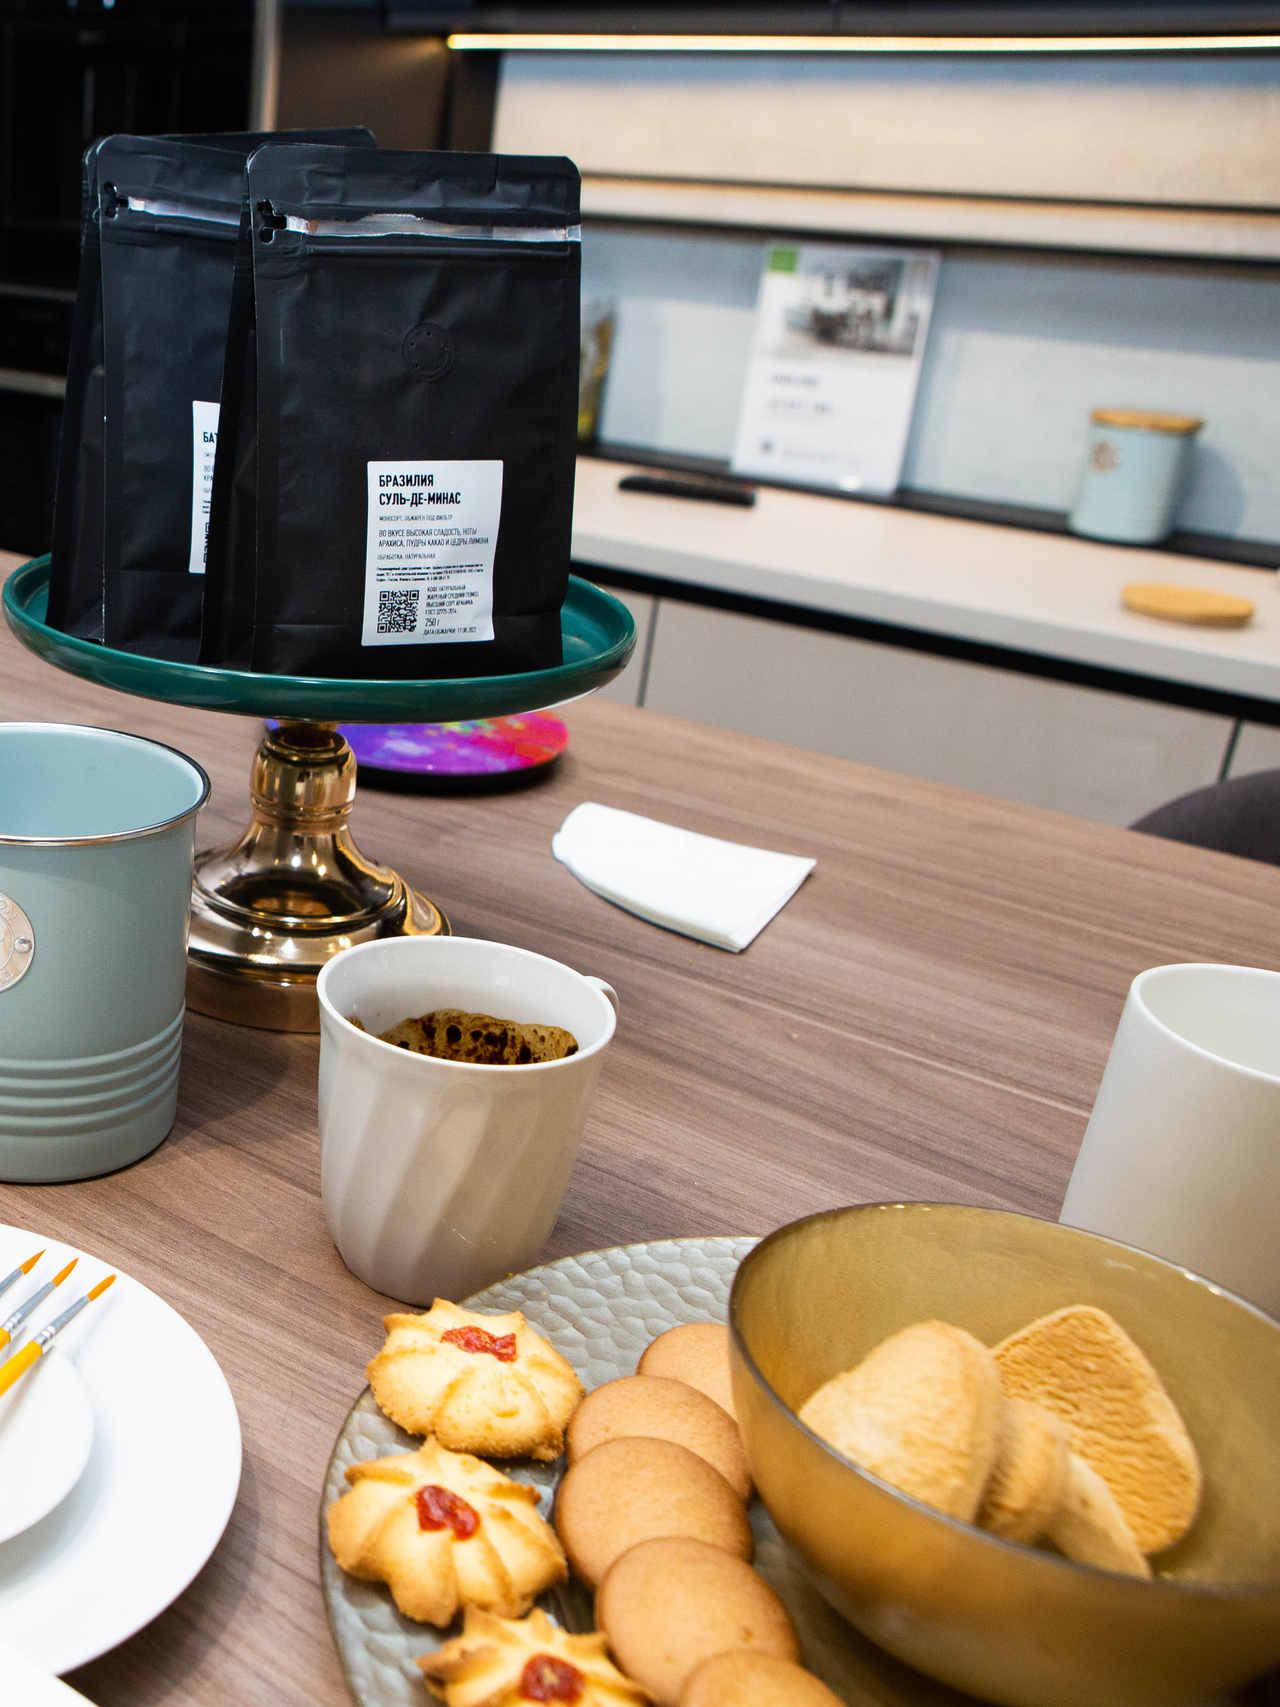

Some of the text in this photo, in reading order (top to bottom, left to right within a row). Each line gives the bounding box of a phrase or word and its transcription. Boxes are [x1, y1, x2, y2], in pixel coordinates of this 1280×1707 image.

[379, 474, 434, 487] БРАЗИЛИЯ
[379, 492, 461, 507] СУЛЬ-ДЕ-МИНАС
[387, 529, 405, 537] ВКУСЕ
[406, 529, 433, 537] ВЫСОКАЯ
[433, 528, 461, 537] СЛАДОСТЬ,
[378, 539, 405, 548] АРАХИСА,
[406, 539, 427, 547] ПУДРЫ
[427, 538, 444, 546] КАКАО
[450, 537, 468, 546] ЦЕДРЫ
[468, 537, 489, 545] ЛИМОНА
[425, 619, 436, 627] 250
